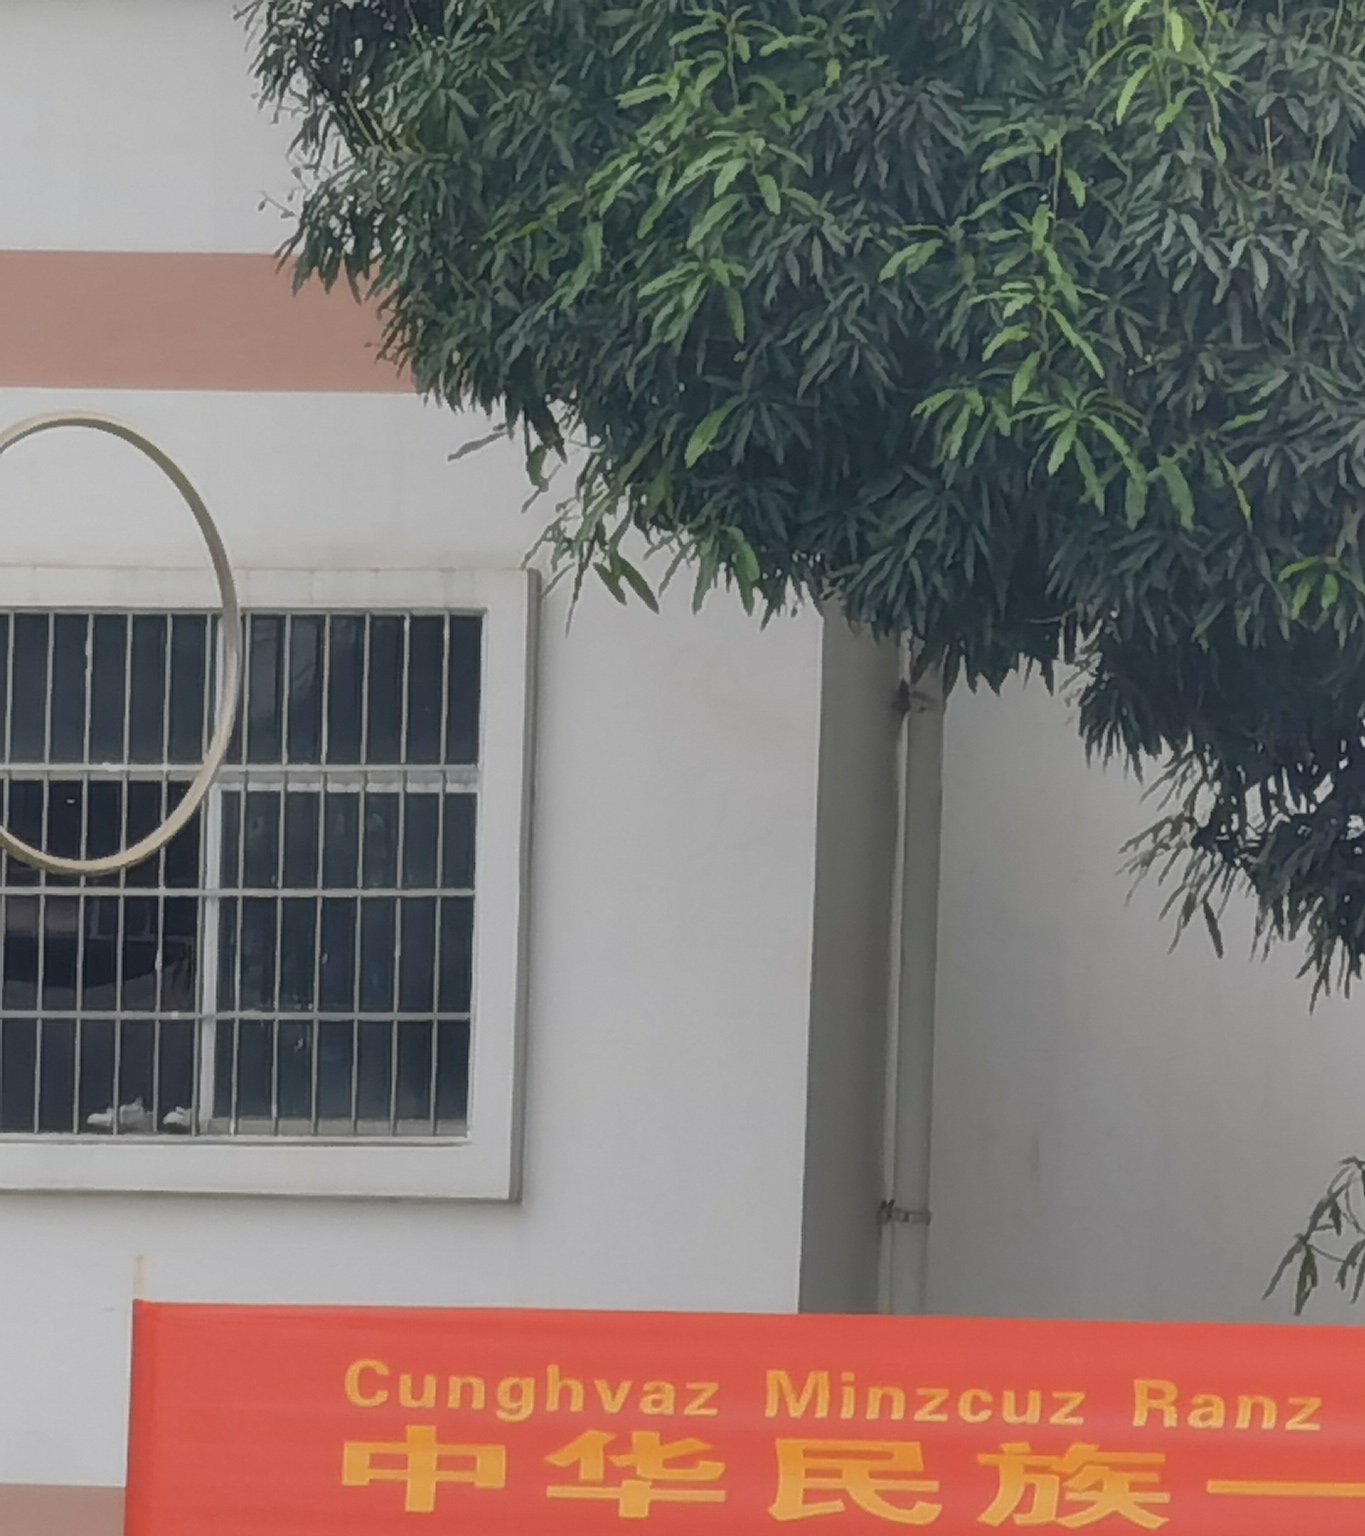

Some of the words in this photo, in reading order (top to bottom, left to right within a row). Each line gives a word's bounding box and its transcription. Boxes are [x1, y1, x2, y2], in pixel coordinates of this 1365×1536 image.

[344, 1359, 719, 1423] Cunghvaz
[765, 1370, 1086, 1424] Minzcuz
[1132, 1379, 1322, 1431] Ranz
